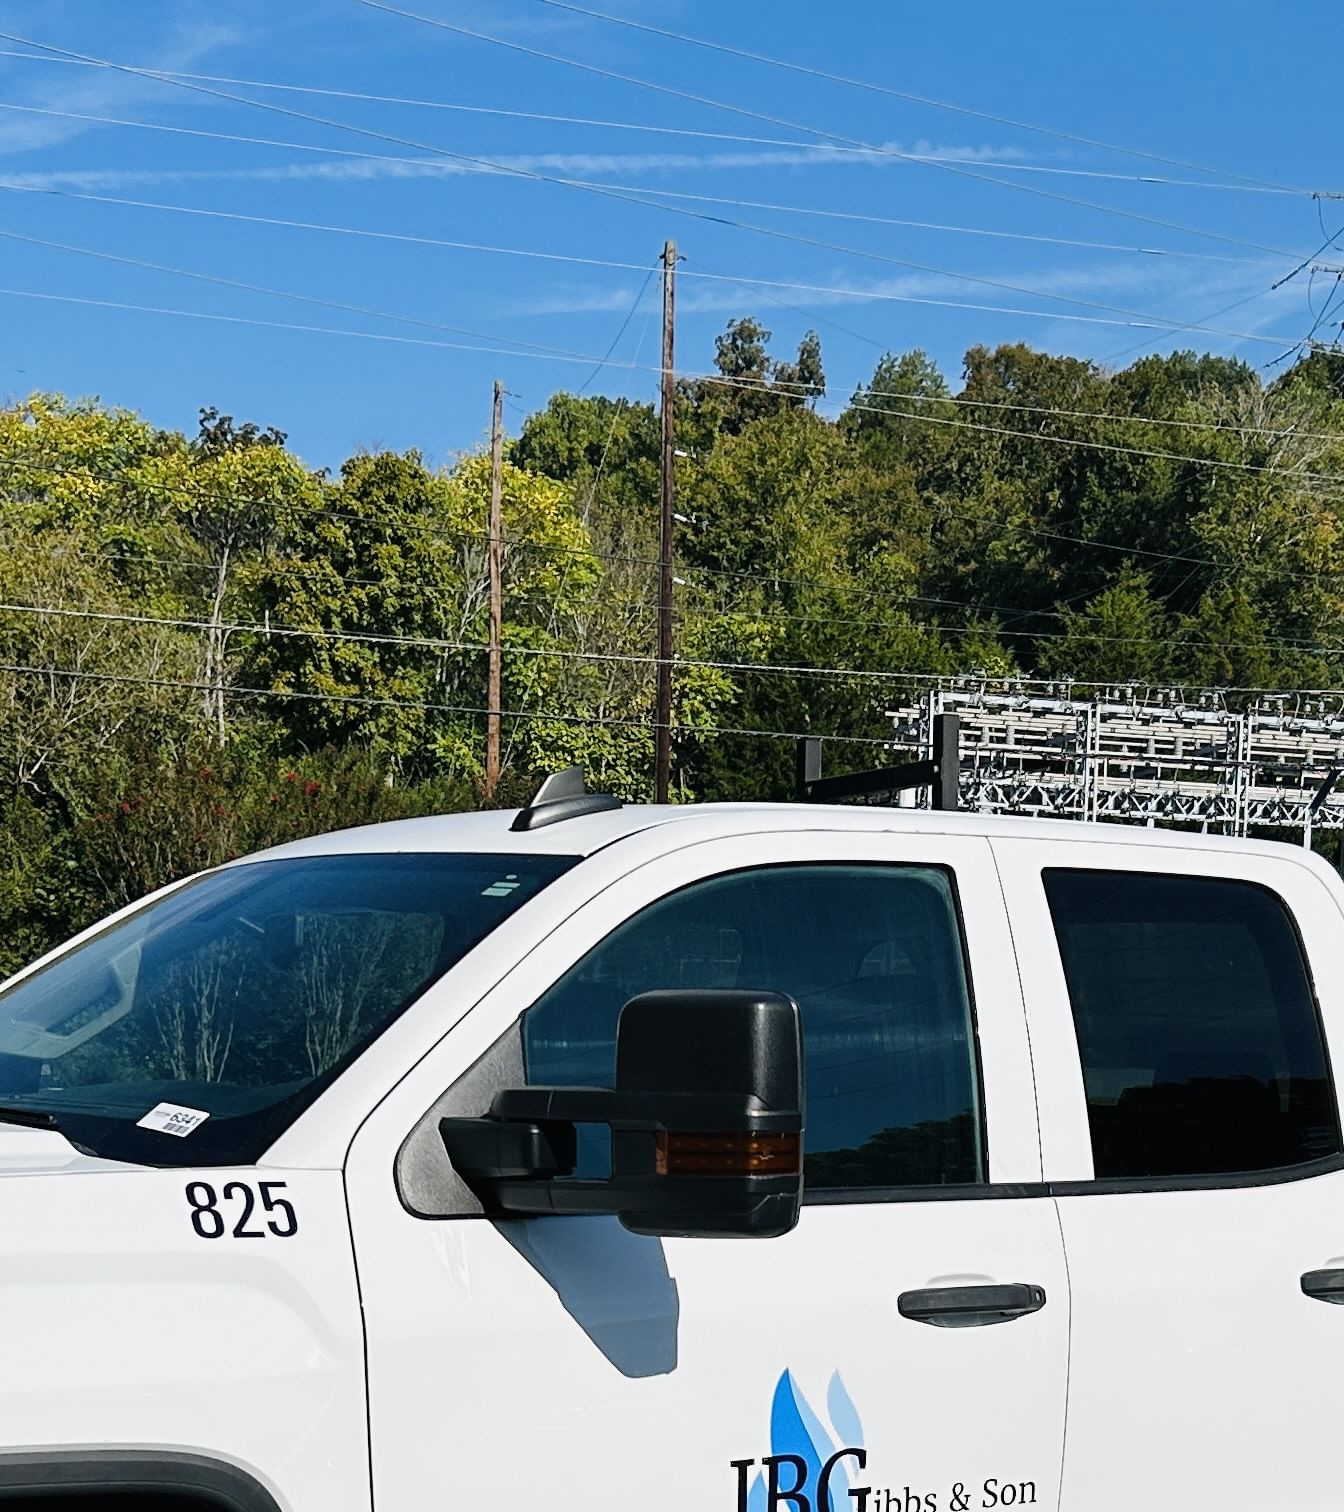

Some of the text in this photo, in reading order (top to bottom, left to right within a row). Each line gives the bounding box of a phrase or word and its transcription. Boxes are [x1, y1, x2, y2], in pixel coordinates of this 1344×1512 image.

[185, 1181, 298, 1239] 825
[949, 1482, 971, 1512] &
[982, 1478, 1037, 1508] Son
